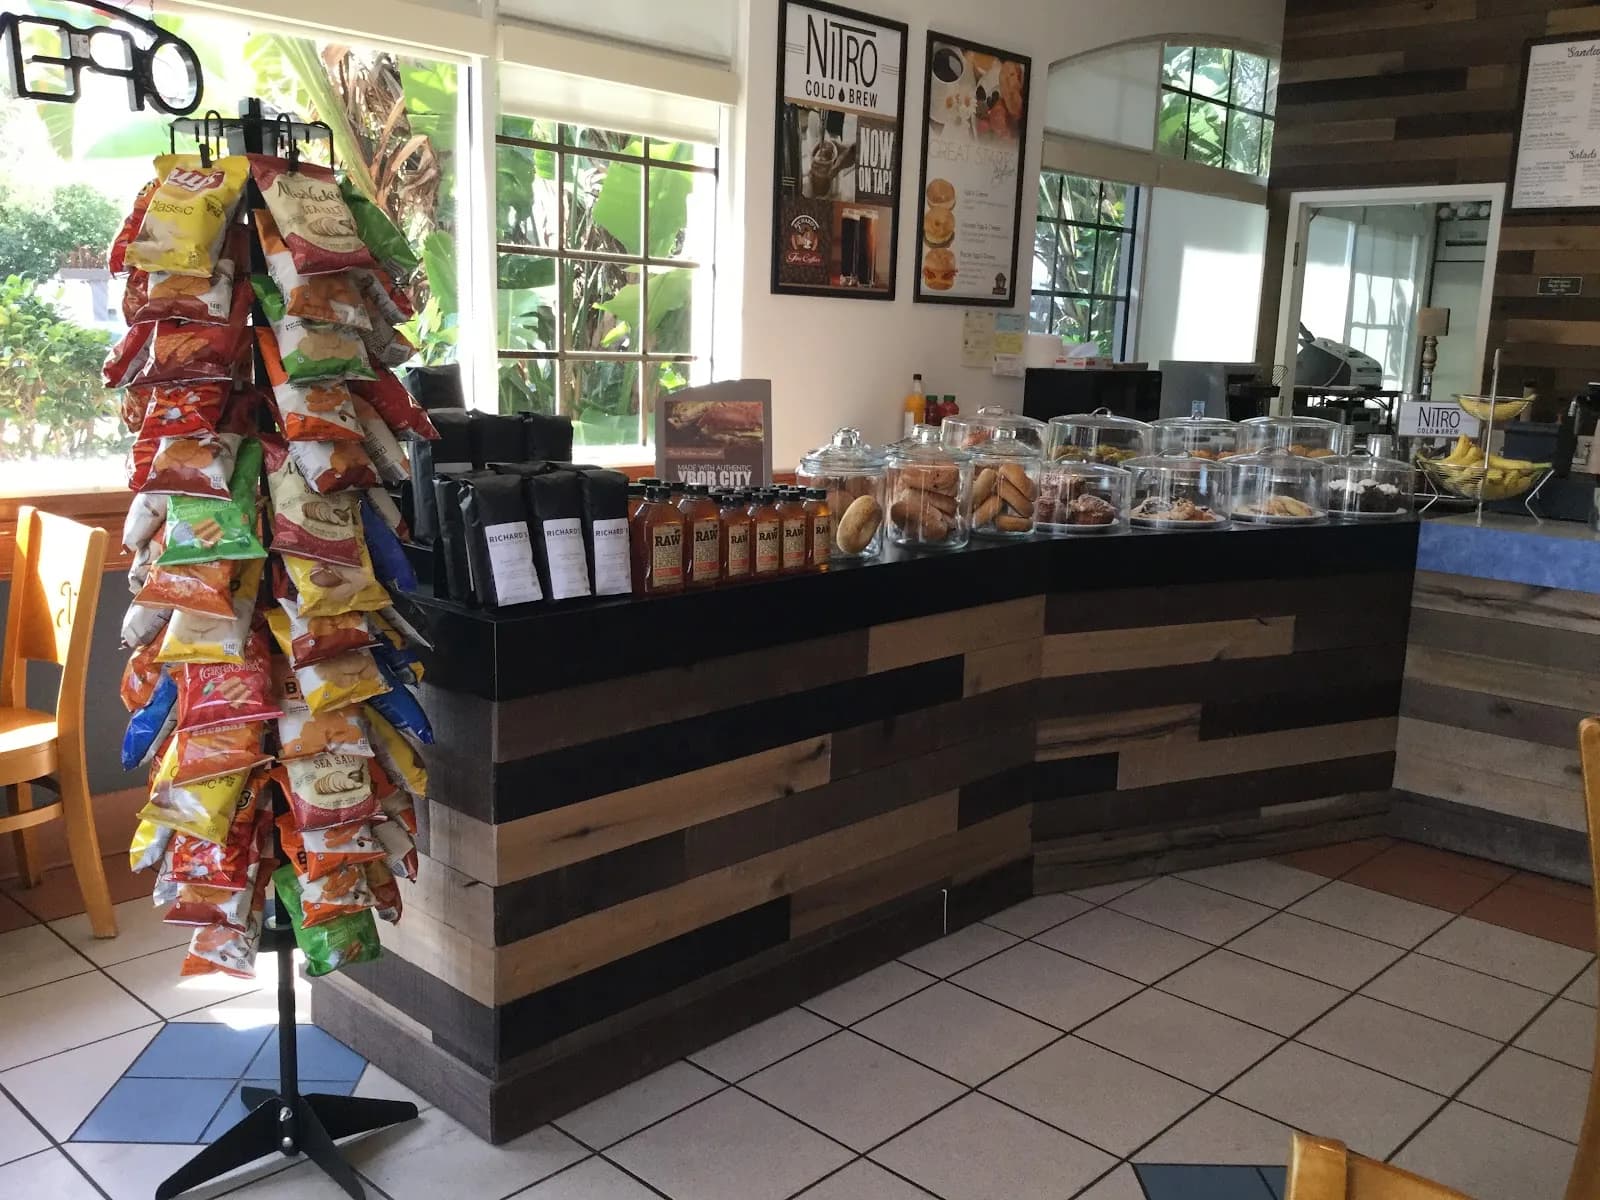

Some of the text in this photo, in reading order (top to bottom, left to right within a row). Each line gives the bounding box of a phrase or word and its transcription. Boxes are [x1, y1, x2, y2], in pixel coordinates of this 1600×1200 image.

[805, 14, 878, 88] NITRO
[805, 79, 878, 109] COLD BREW
[860, 127, 894, 169] NOW
[1568, 149, 1597, 160] Salads
[859, 167, 892, 196] ON TAP!
[1418, 406, 1461, 428] NITRO
[717, 464, 752, 472] AUTHENTIC
[678, 471, 752, 486] YBOR CITY
[546, 528, 580, 537] RICHARD'
[695, 530, 718, 542] RAW
[758, 531, 778, 541] RAW
[785, 527, 804, 538] RAW
[654, 534, 681, 547] RAW
[313, 757, 333, 769] SEA
